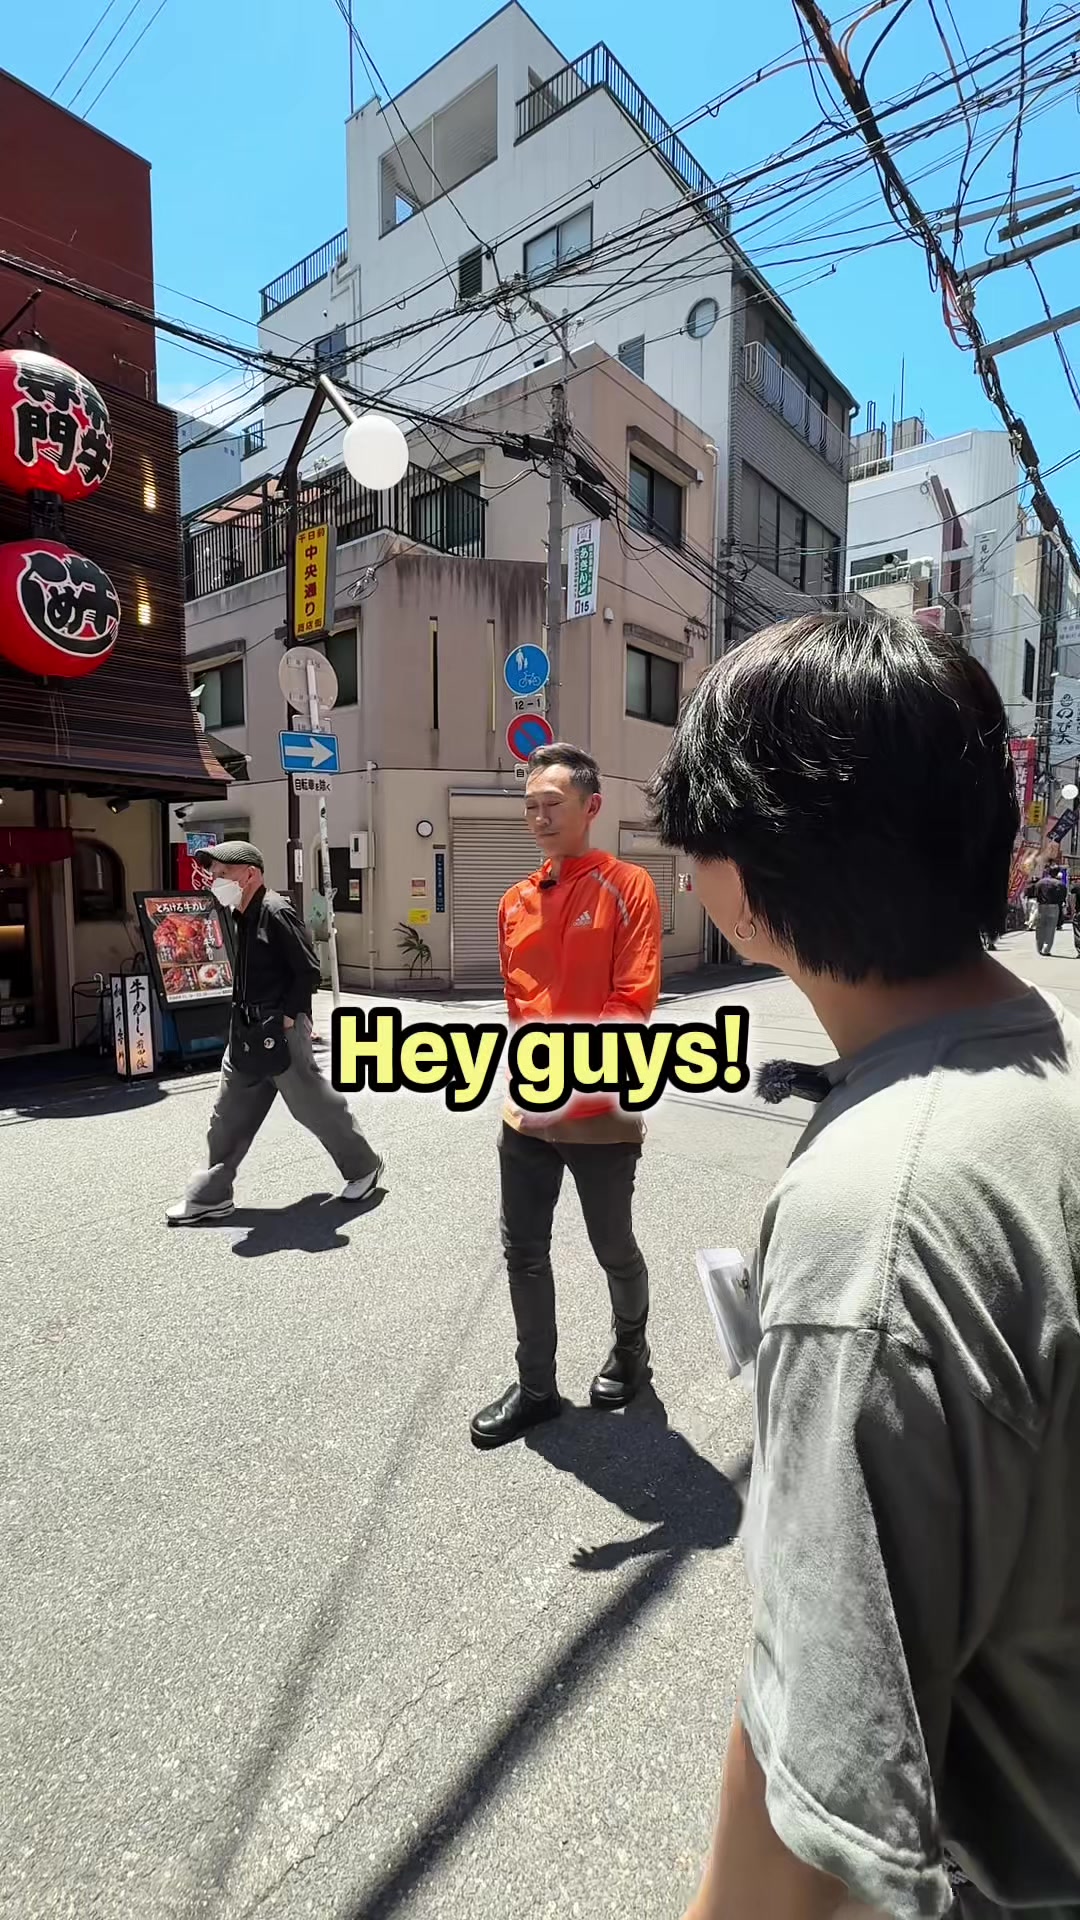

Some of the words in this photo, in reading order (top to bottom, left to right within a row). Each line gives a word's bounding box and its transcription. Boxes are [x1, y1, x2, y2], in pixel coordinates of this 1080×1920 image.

[304, 544, 318, 617] 中央通り
[295, 778, 331, 792] 自転車を除く
